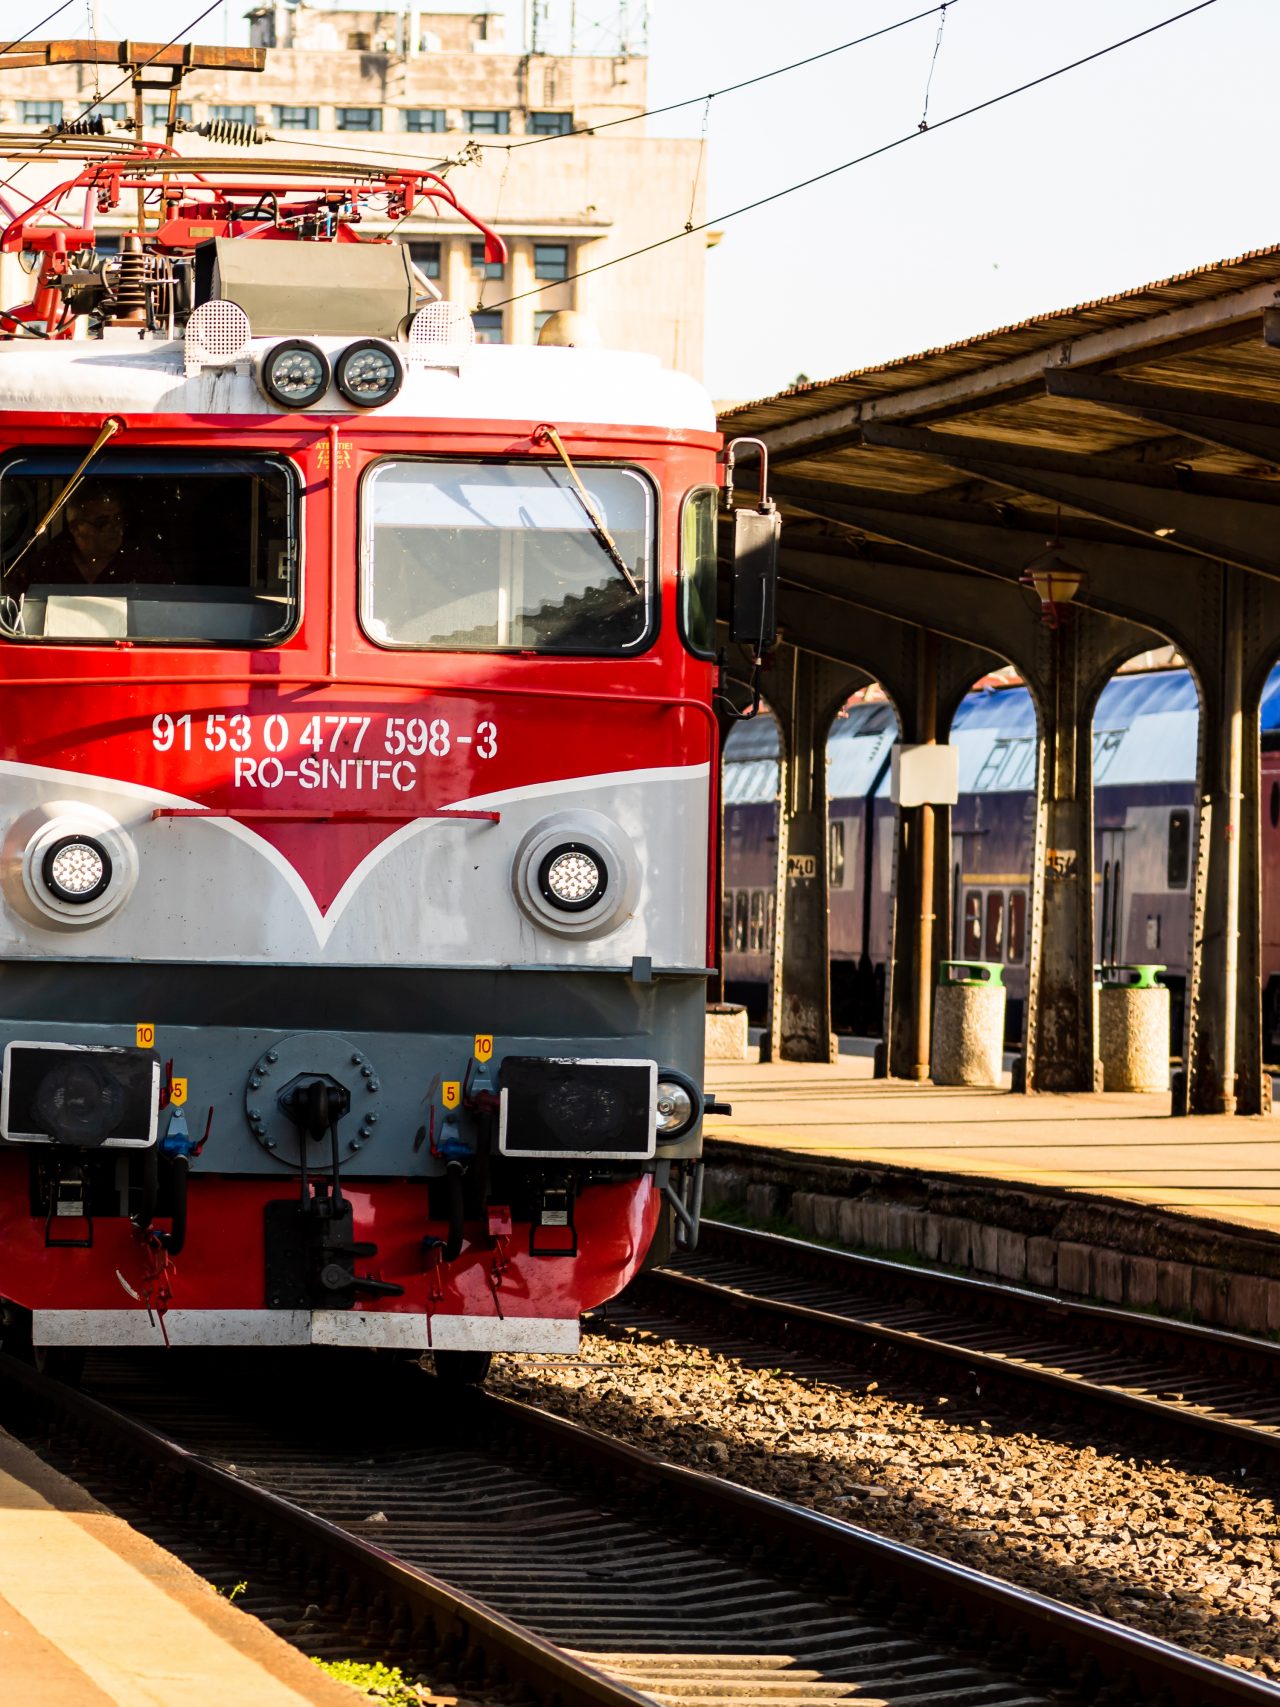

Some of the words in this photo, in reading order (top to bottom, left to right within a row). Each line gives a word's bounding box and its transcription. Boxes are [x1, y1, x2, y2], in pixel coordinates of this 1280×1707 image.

[152, 713, 192, 752] 91
[204, 714, 252, 753] 53
[262, 714, 290, 753] 0
[298, 715, 372, 757] 477
[234, 756, 417, 792] RO-SNTFC
[137, 1027, 153, 1043] 10
[475, 1038, 492, 1054] 10
[173, 1083, 183, 1098] 5
[446, 1086, 456, 1102] 5
